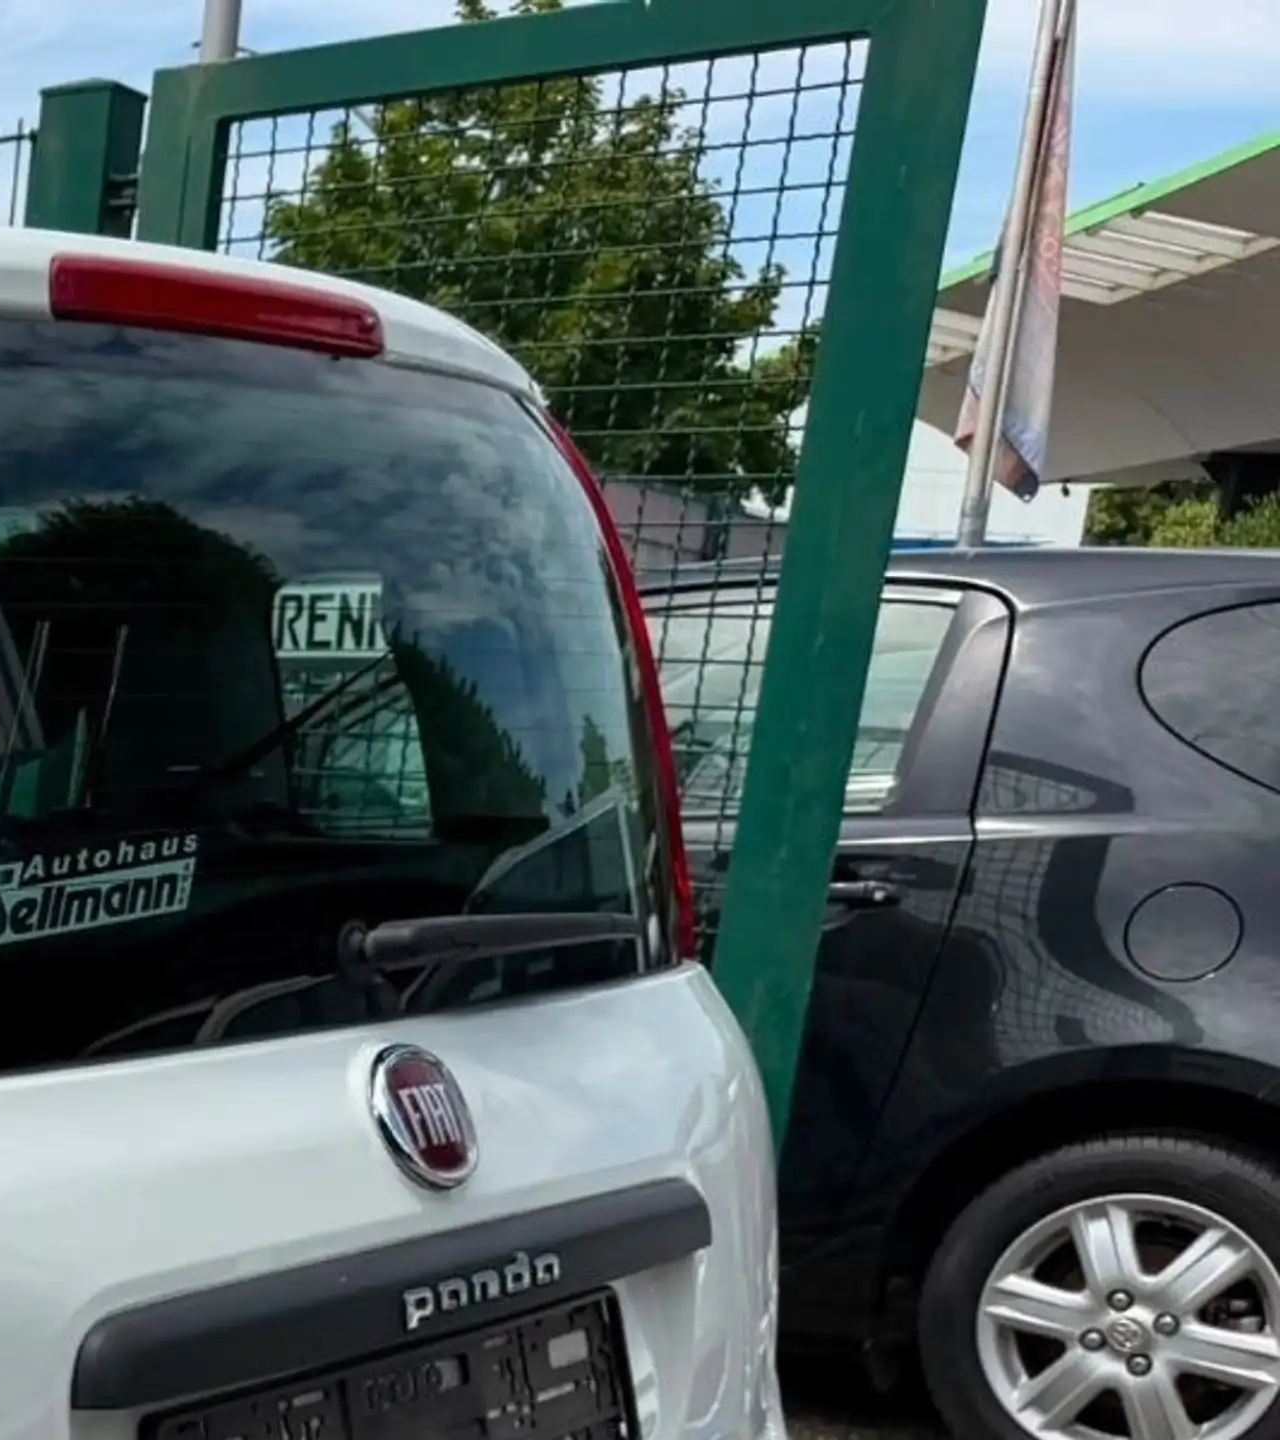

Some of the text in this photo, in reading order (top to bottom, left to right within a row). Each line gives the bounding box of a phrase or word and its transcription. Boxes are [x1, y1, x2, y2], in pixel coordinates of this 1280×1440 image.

[23, 833, 200, 882] Autohaus
[397, 1082, 463, 1150] FIAT
[403, 1251, 561, 1331] panda
